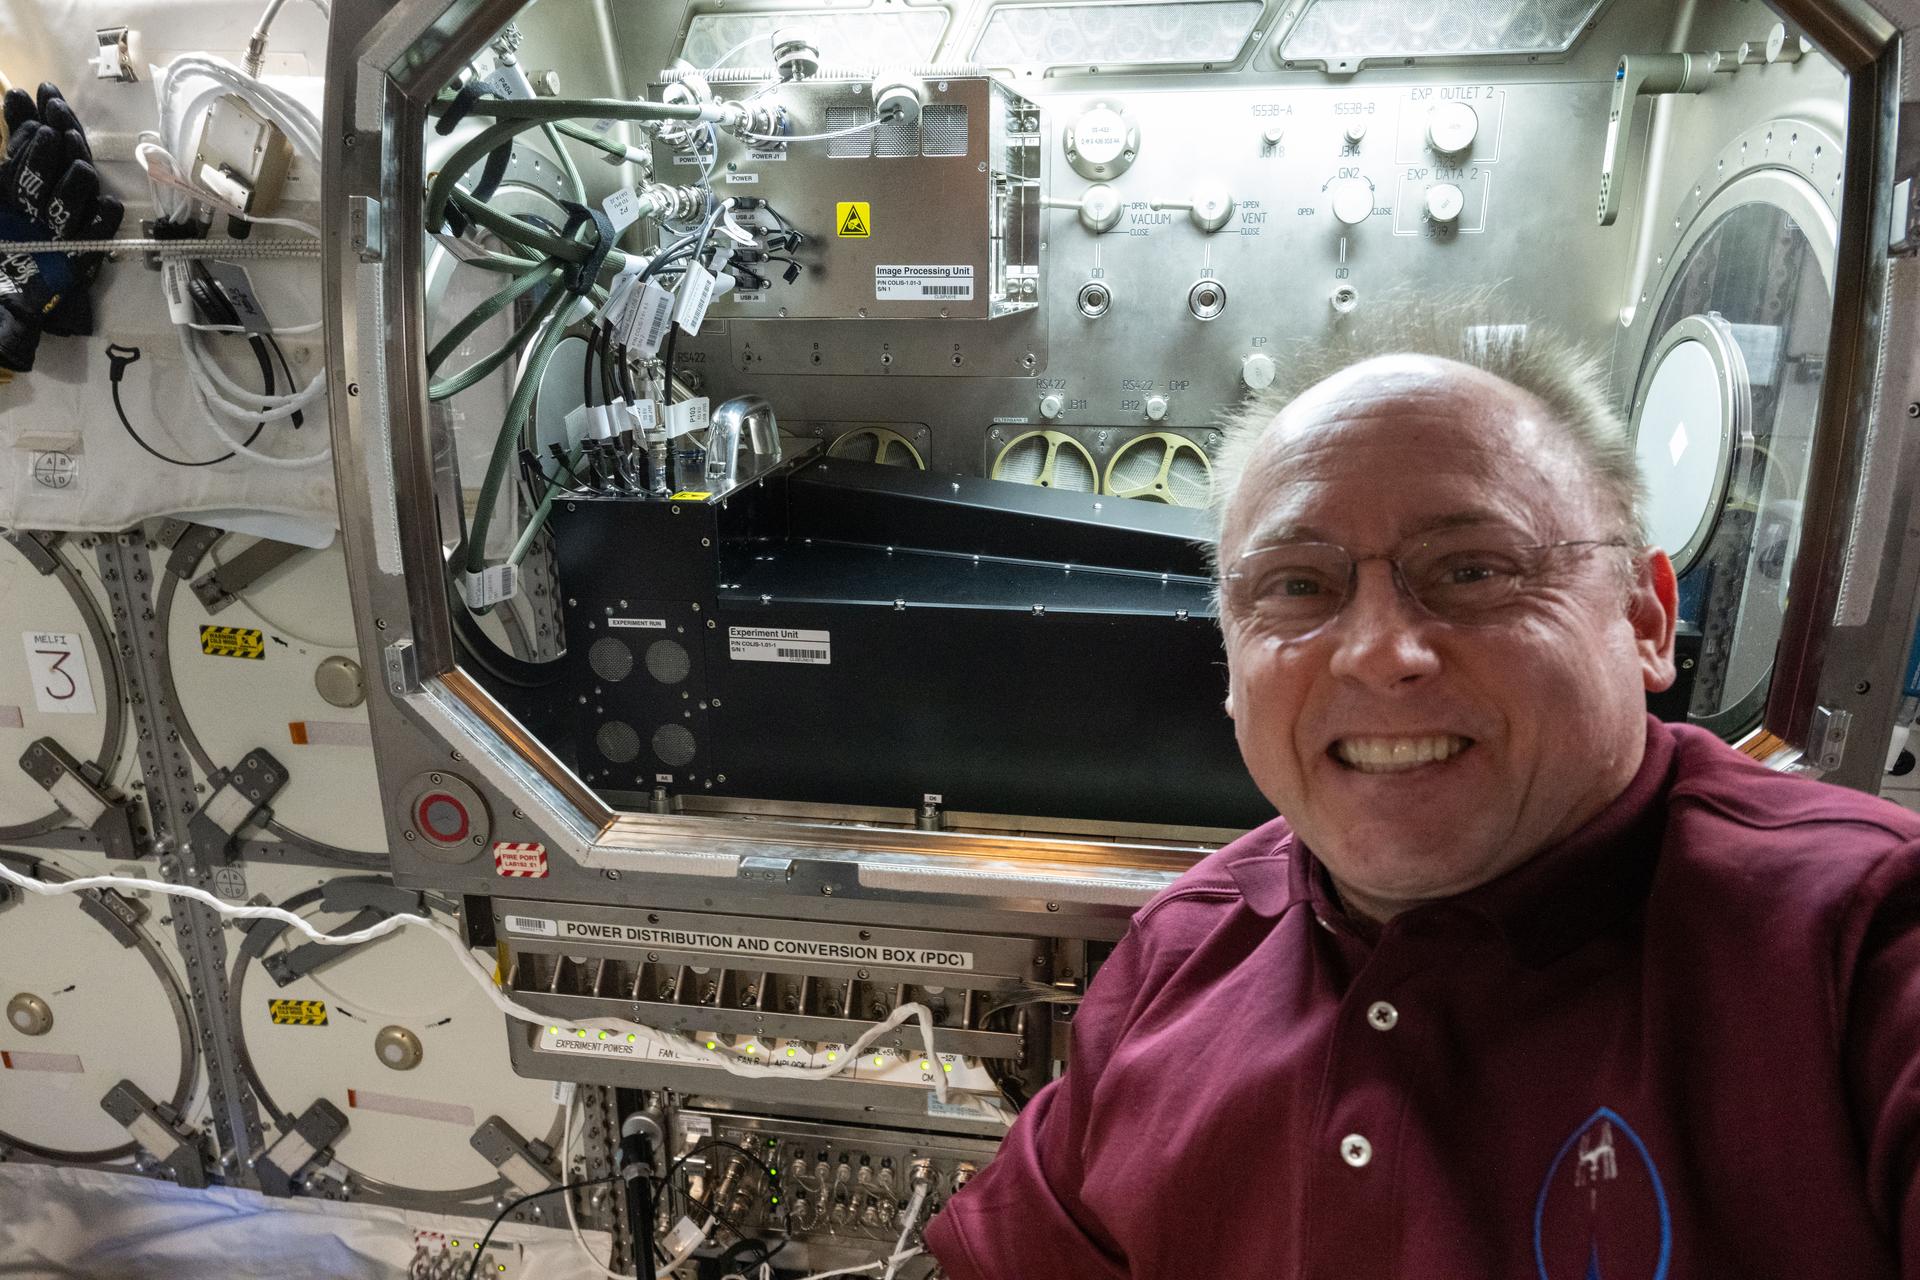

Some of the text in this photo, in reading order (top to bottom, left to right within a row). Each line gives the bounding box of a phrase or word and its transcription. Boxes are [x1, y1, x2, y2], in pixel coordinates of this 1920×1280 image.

[498, 77, 513, 96] P404
[1411, 86, 1494, 100] EXP OUTLET 2
[1250, 104, 1293, 117] 1553B-A
[1333, 103, 1375, 115] 1553B-B
[1259, 144, 1285, 158] J318
[1338, 145, 1361, 158] J314
[1338, 167, 1360, 179] GN2
[1407, 167, 1478, 181] EXP DATA 2
[1131, 202, 1148, 210] OPEN
[1242, 201, 1260, 209] OPEN
[1297, 208, 1315, 216] OPEN
[1372, 207, 1392, 216] CLOSE
[1130, 213, 1172, 225] VACUUM
[1241, 212, 1268, 224] VENT
[1129, 228, 1150, 236] CLOSE
[1240, 227, 1260, 235] CLOSE
[876, 266, 970, 277] Image Processing Unit
[1091, 267, 1104, 279] QD
[1335, 268, 1349, 279] QD
[883, 343, 889, 351] C
[954, 343, 960, 351] D
[678, 353, 706, 363] RS422
[1036, 379, 1066, 390] RS422
[1122, 380, 1153, 391] RS422
[1169, 380, 1190, 390] CMP
[1067, 400, 1088, 411] J311
[1120, 401, 1140, 411] J312
[47, 457, 52, 465] A
[730, 628, 799, 638] Experiment Unit
[34, 635, 67, 645] MELFI
[35, 649, 75, 699] 3
[567, 922, 965, 967] POWER DISTRIBUTION AND CONVERSION BOX (PDC)
[555, 1039, 633, 1054] EXPERIMENT POWERS
[658, 1048, 674, 1058] FAN
[940, 1053, 957, 1062] -12V
[737, 1055, 760, 1065] FAN R
